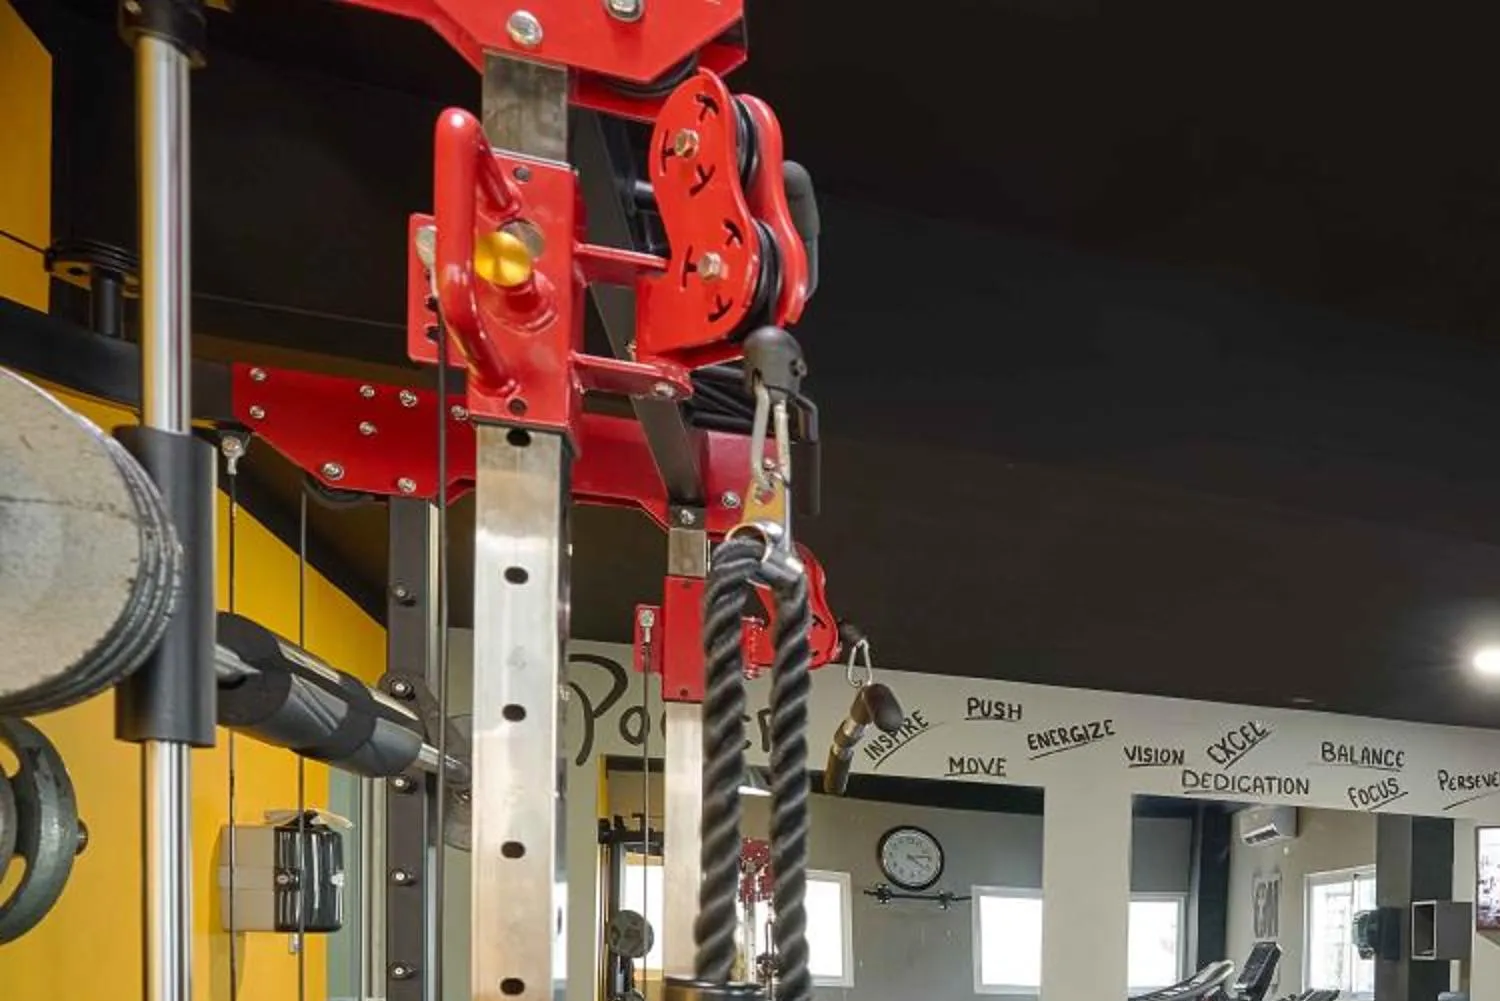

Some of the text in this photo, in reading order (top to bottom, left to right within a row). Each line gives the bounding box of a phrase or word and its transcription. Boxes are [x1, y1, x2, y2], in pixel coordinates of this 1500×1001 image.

[967, 697, 1023, 720] PUSH
[863, 710, 929, 761] INSPIRE
[1027, 719, 1116, 751] ENERGIZE
[1206, 721, 1266, 765] EXCEL
[949, 757, 1007, 776] MOVE
[1123, 745, 1185, 765] VISION
[1321, 741, 1405, 768] BALANCE
[1181, 769, 1310, 795] DEDICATION
[1347, 777, 1400, 809] FOCUS
